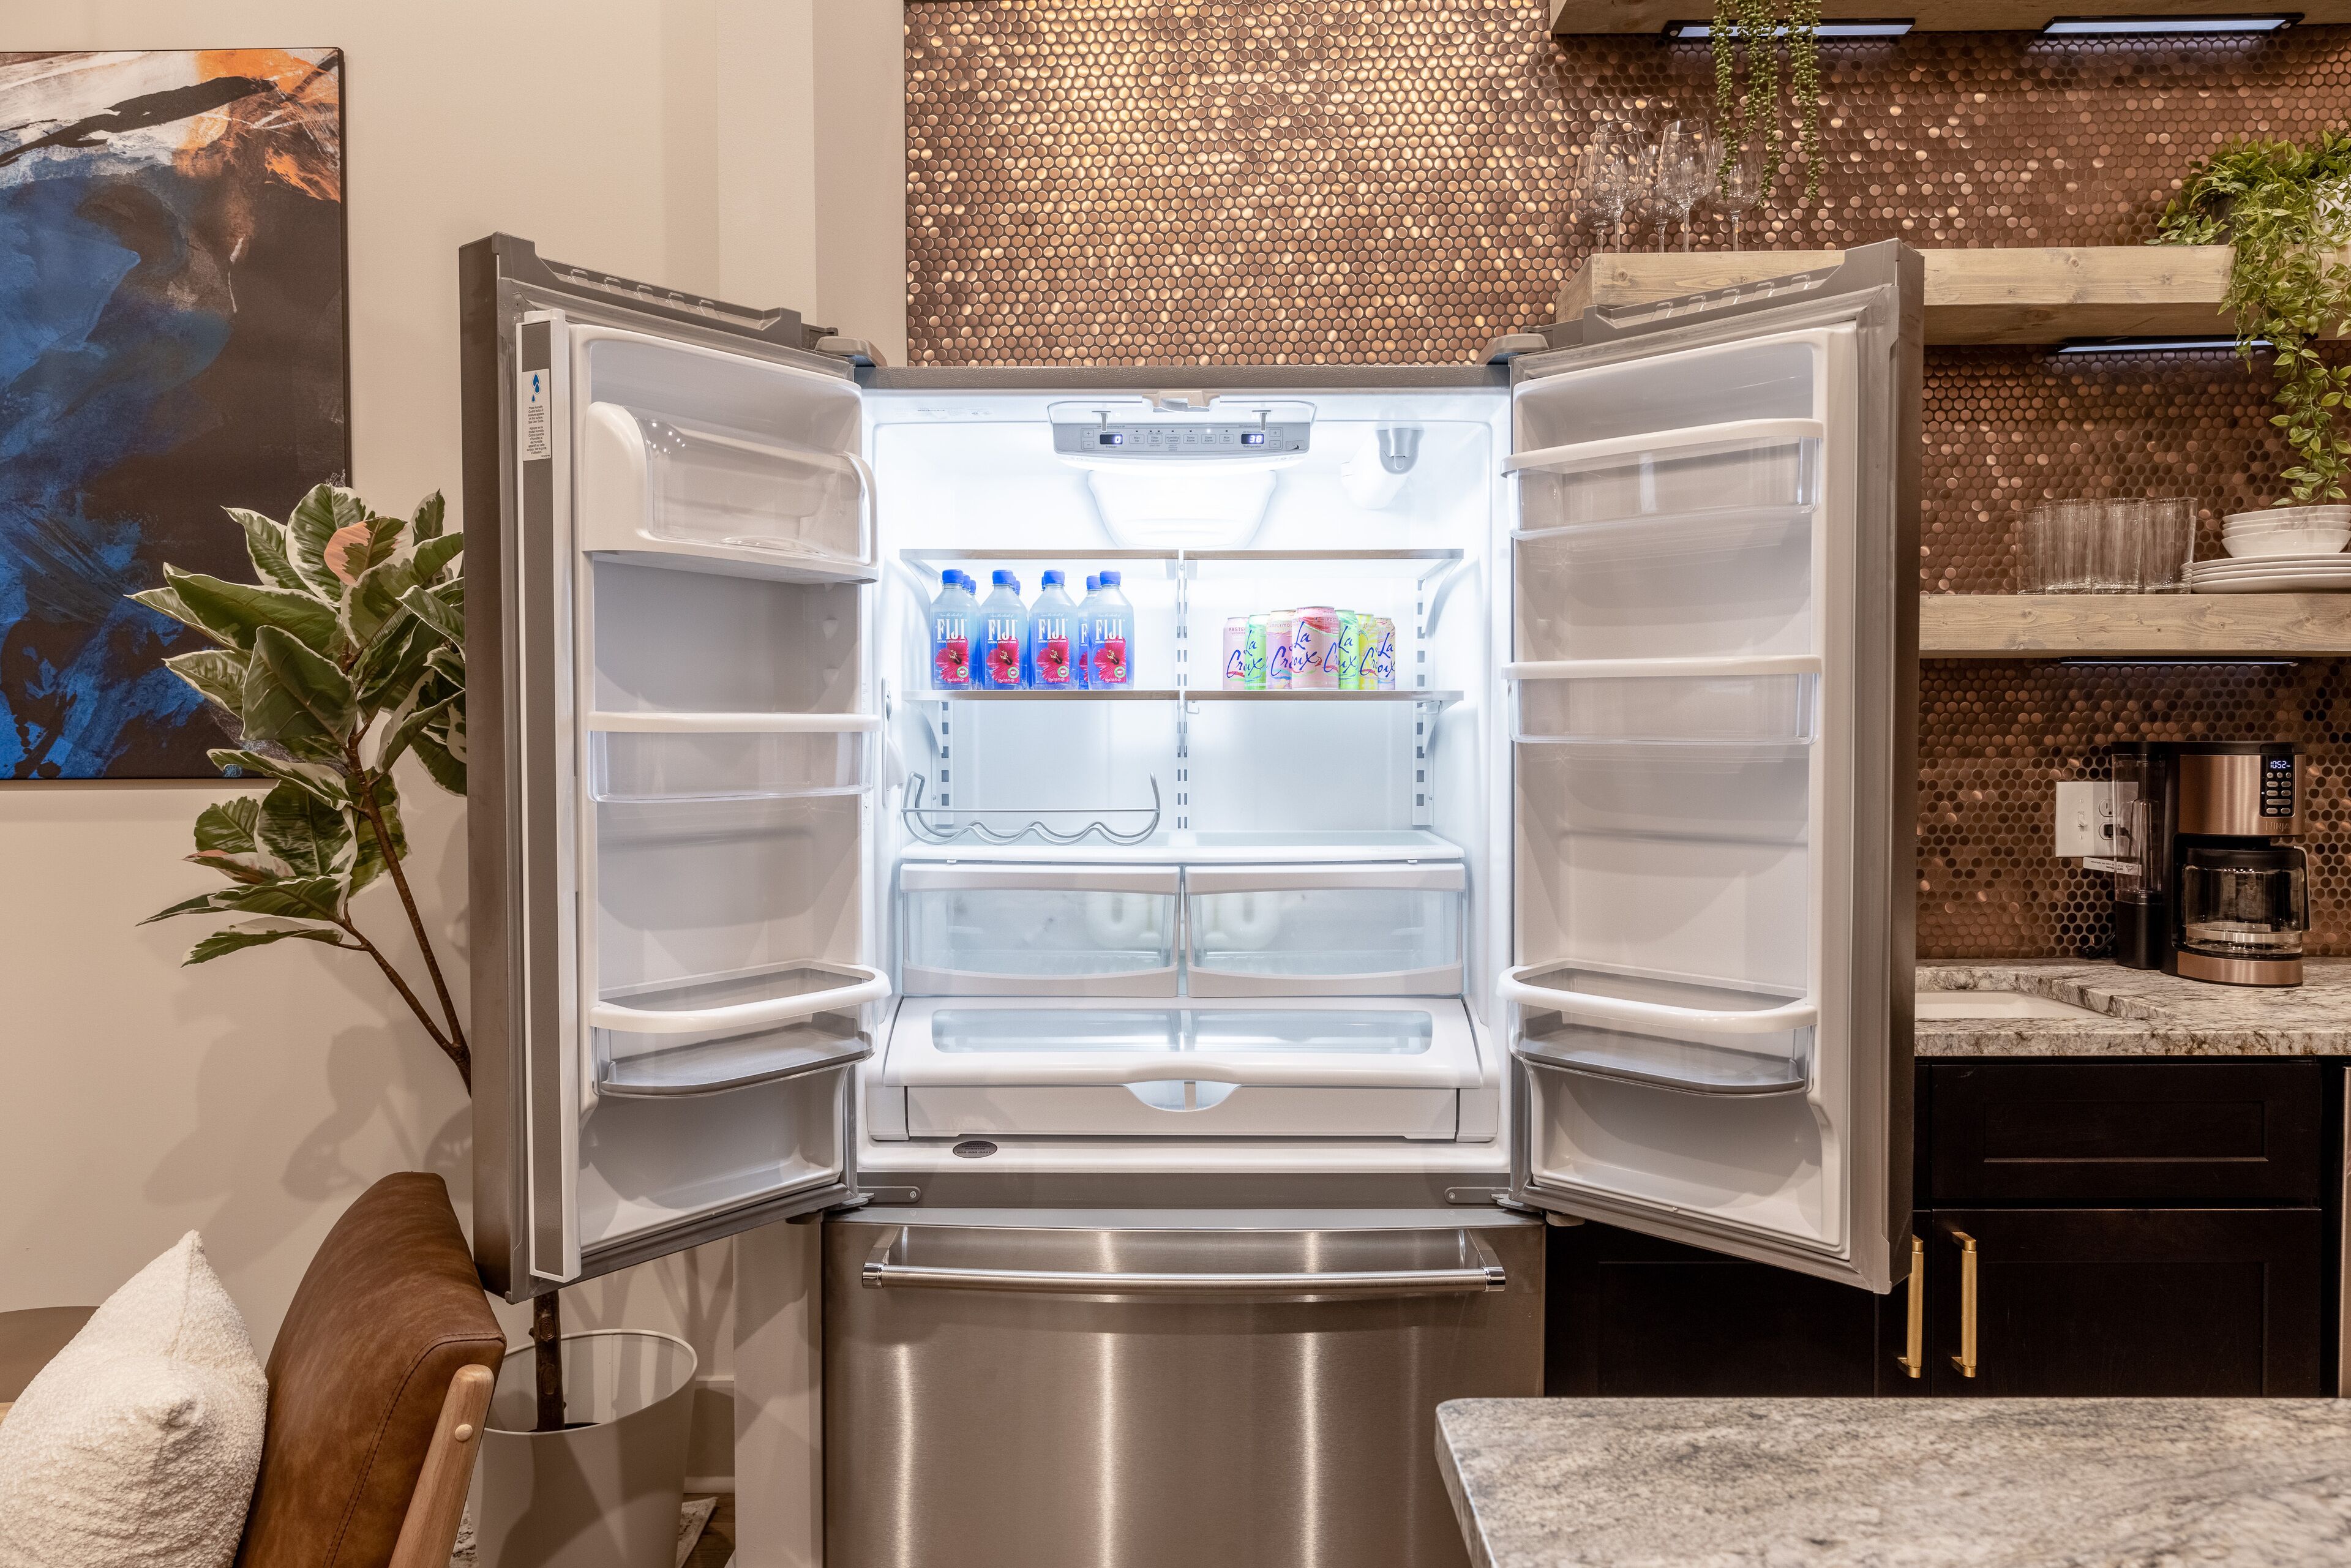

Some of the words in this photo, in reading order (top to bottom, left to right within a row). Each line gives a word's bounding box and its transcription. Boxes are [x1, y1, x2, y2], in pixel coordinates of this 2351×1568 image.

[937, 619, 966, 640] FIJI
[988, 619, 1016, 640] FIJI
[1038, 618, 1066, 640] FIJI
[1095, 619, 1123, 640] FIJI
[1294, 621, 1311, 650] La
[1338, 626, 1354, 654] La
[1378, 632, 1394, 659] La
